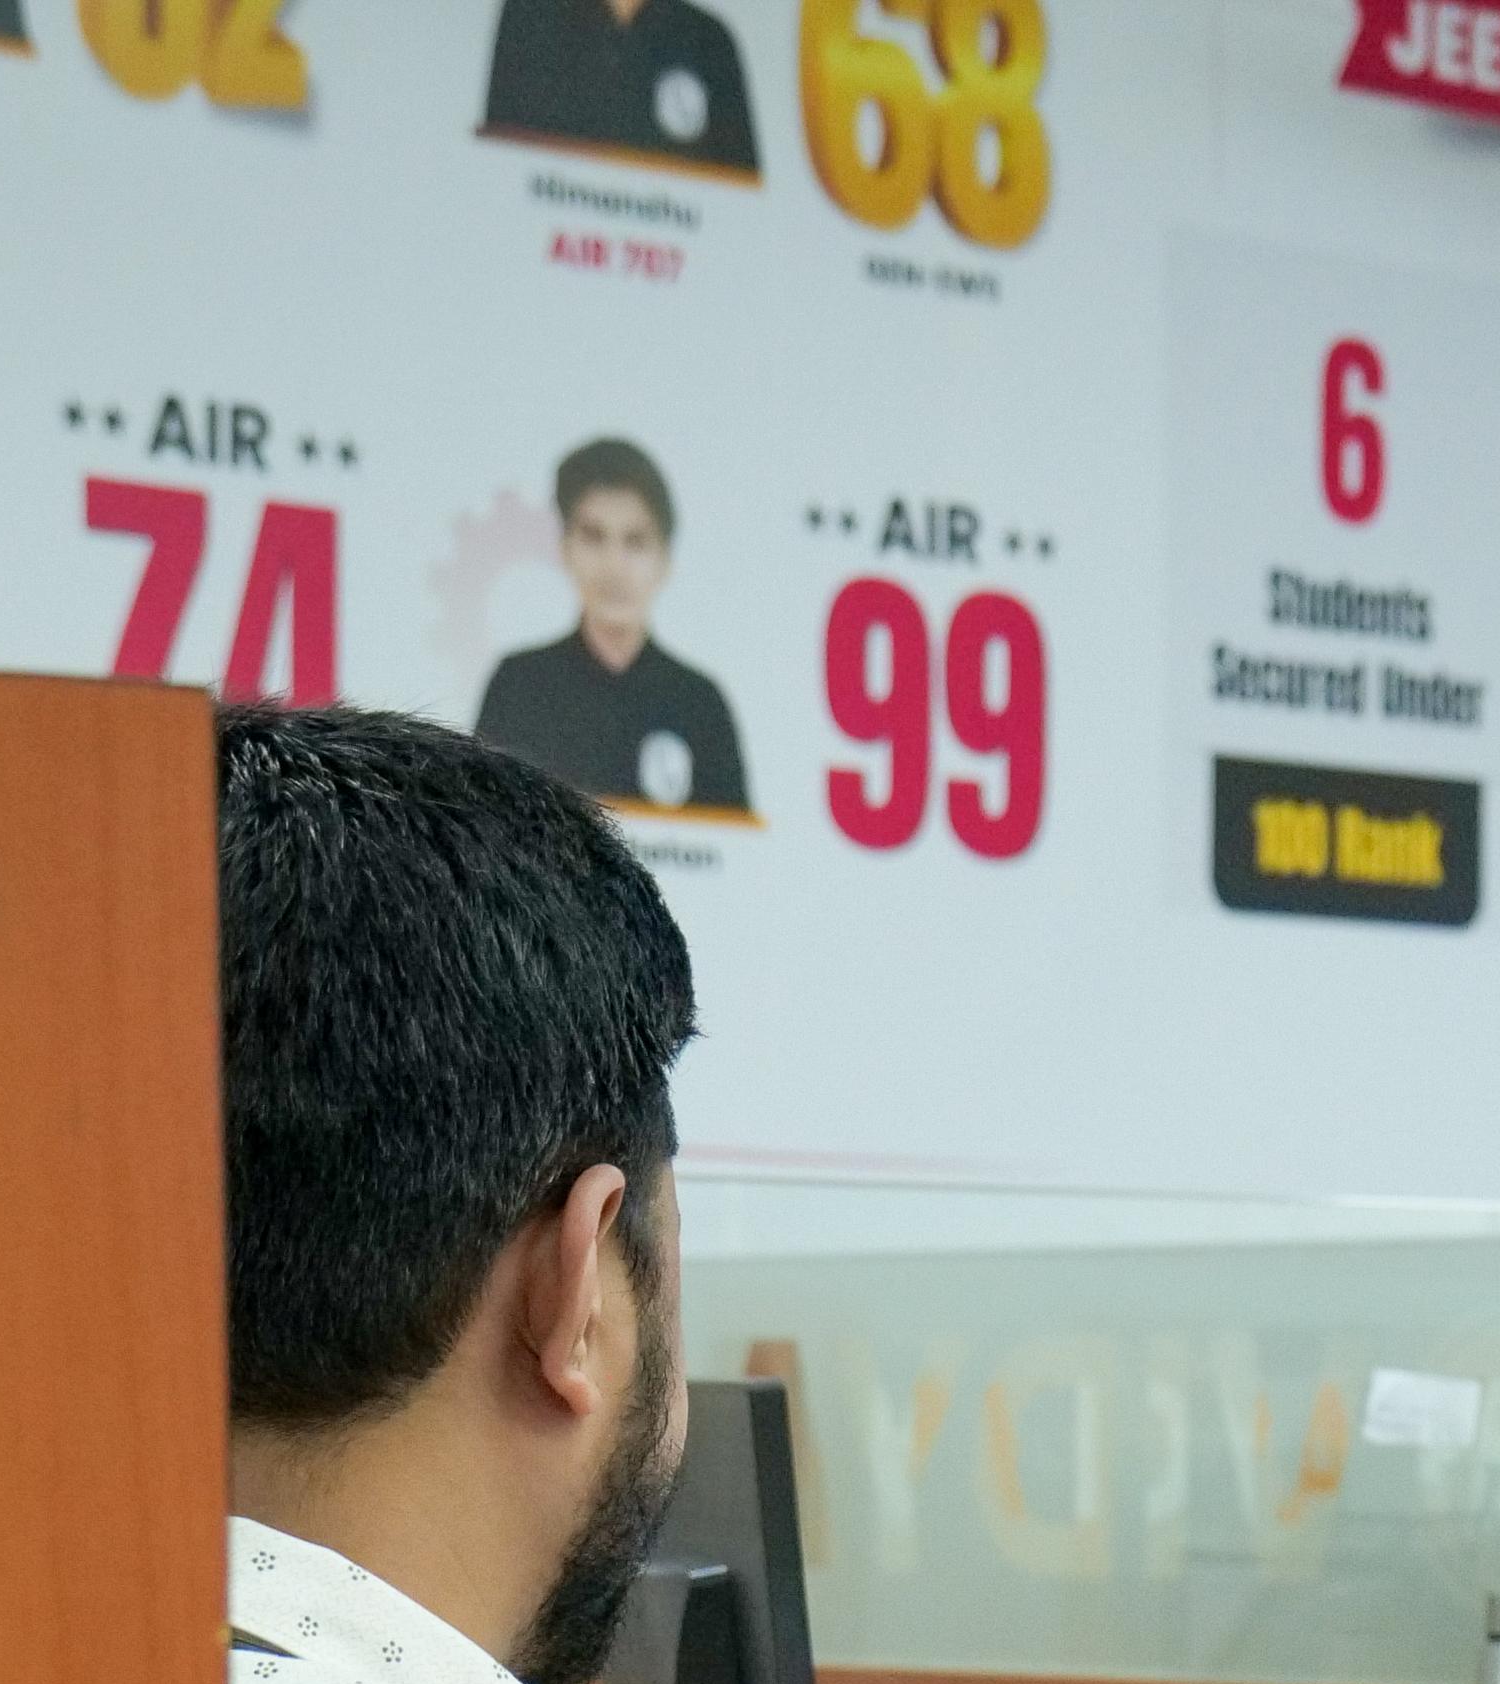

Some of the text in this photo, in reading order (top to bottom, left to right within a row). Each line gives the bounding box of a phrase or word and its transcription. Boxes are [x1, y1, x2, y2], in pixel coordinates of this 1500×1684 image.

[798, 0, 1052, 250] 68
[550, 232, 610, 270] AIR
[147, 394, 272, 470] AIR
[1319, 337, 1386, 524] 6
[877, 503, 981, 563] AIR
[1268, 566, 1432, 642] Students
[824, 575, 1050, 859] 99
[1211, 645, 1482, 727] Secured Under
[1254, 797, 1444, 889] 100 Rank
